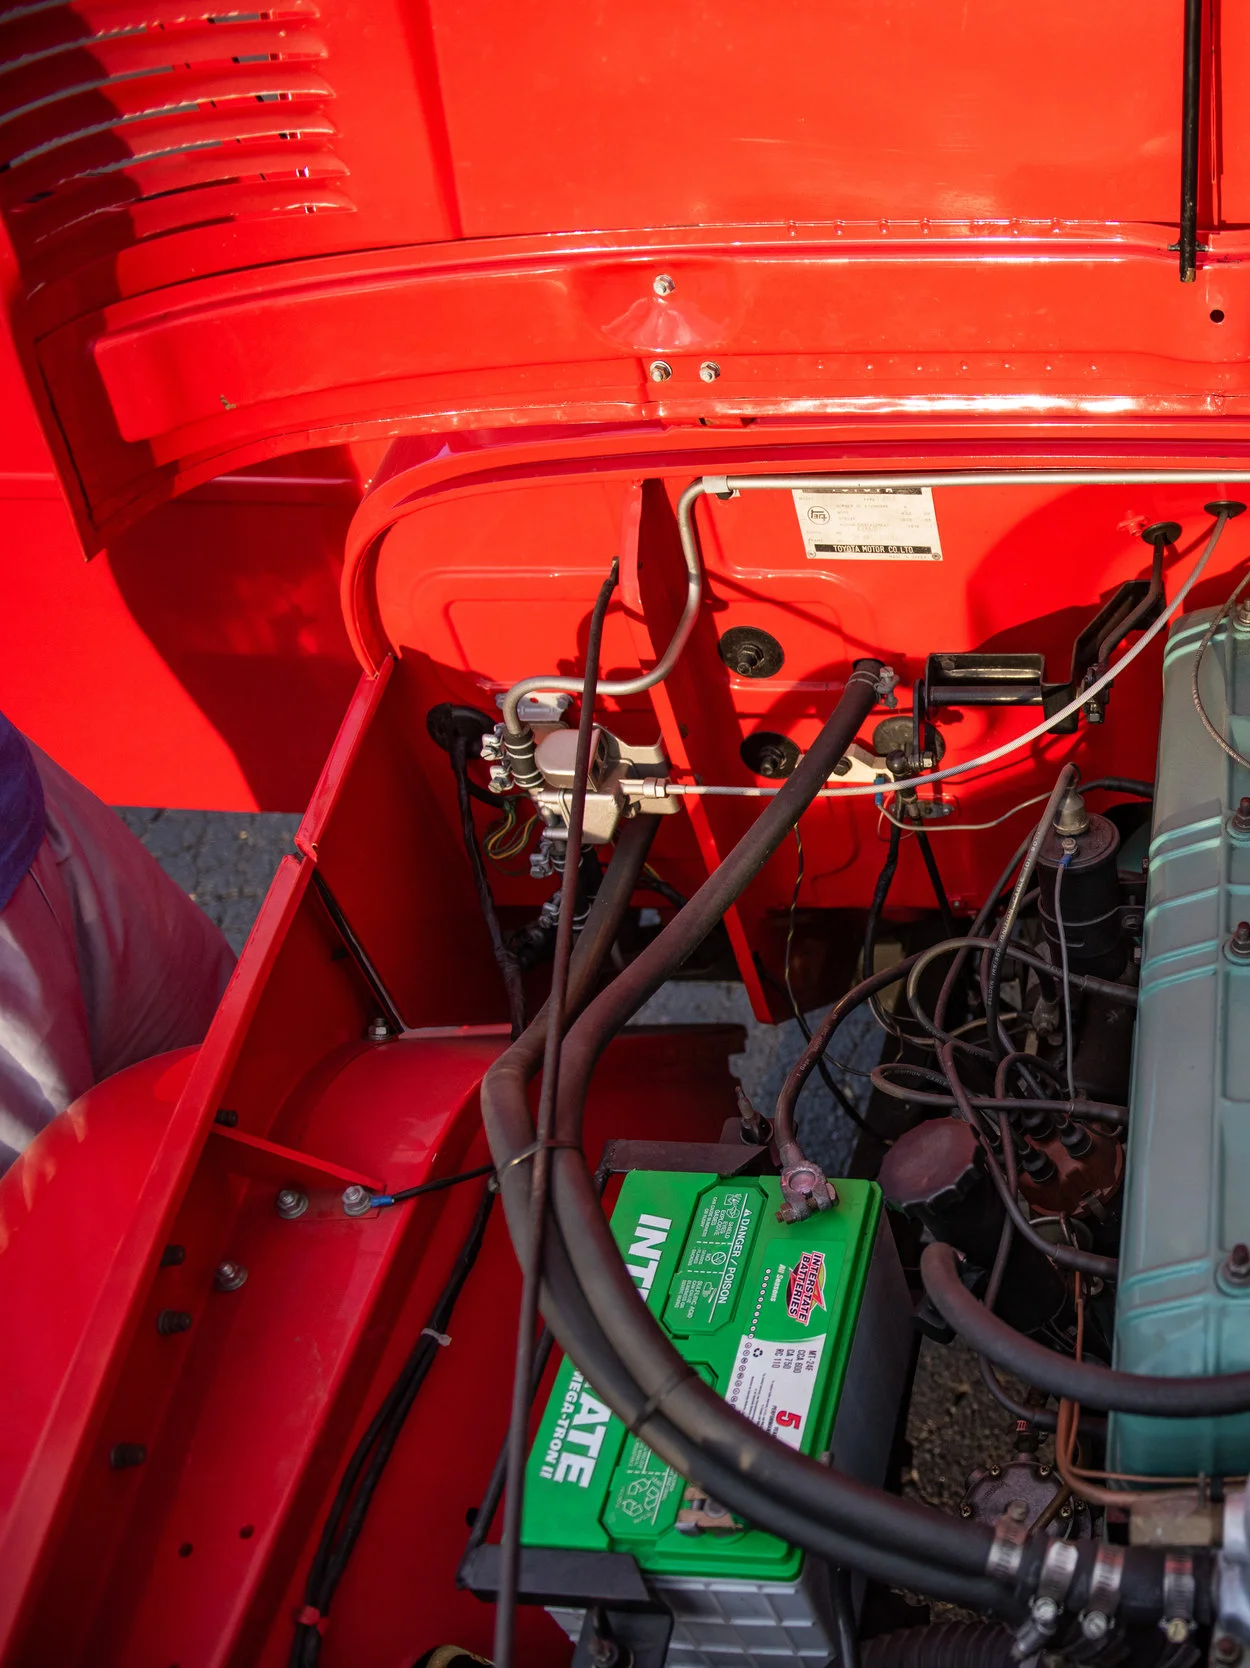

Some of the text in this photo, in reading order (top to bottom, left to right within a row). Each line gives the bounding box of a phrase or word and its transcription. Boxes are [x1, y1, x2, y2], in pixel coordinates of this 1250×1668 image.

[833, 545, 860, 553] TOYOTA
[862, 546, 885, 554] MOTOR
[731, 1217, 749, 1257] DANGER
[717, 1266, 735, 1305] POISON
[769, 1263, 785, 1302] All Seasons
[788, 1255, 810, 1316] BATTERIES
[797, 1253, 821, 1321] INTERSTATE
[781, 1348, 795, 1370] CA 750
[794, 1348, 806, 1362] CCA
[544, 1370, 584, 1465] MEGA-TRON
[765, 1404, 777, 1433] PERFORMAN
[774, 1408, 802, 1430] 5
